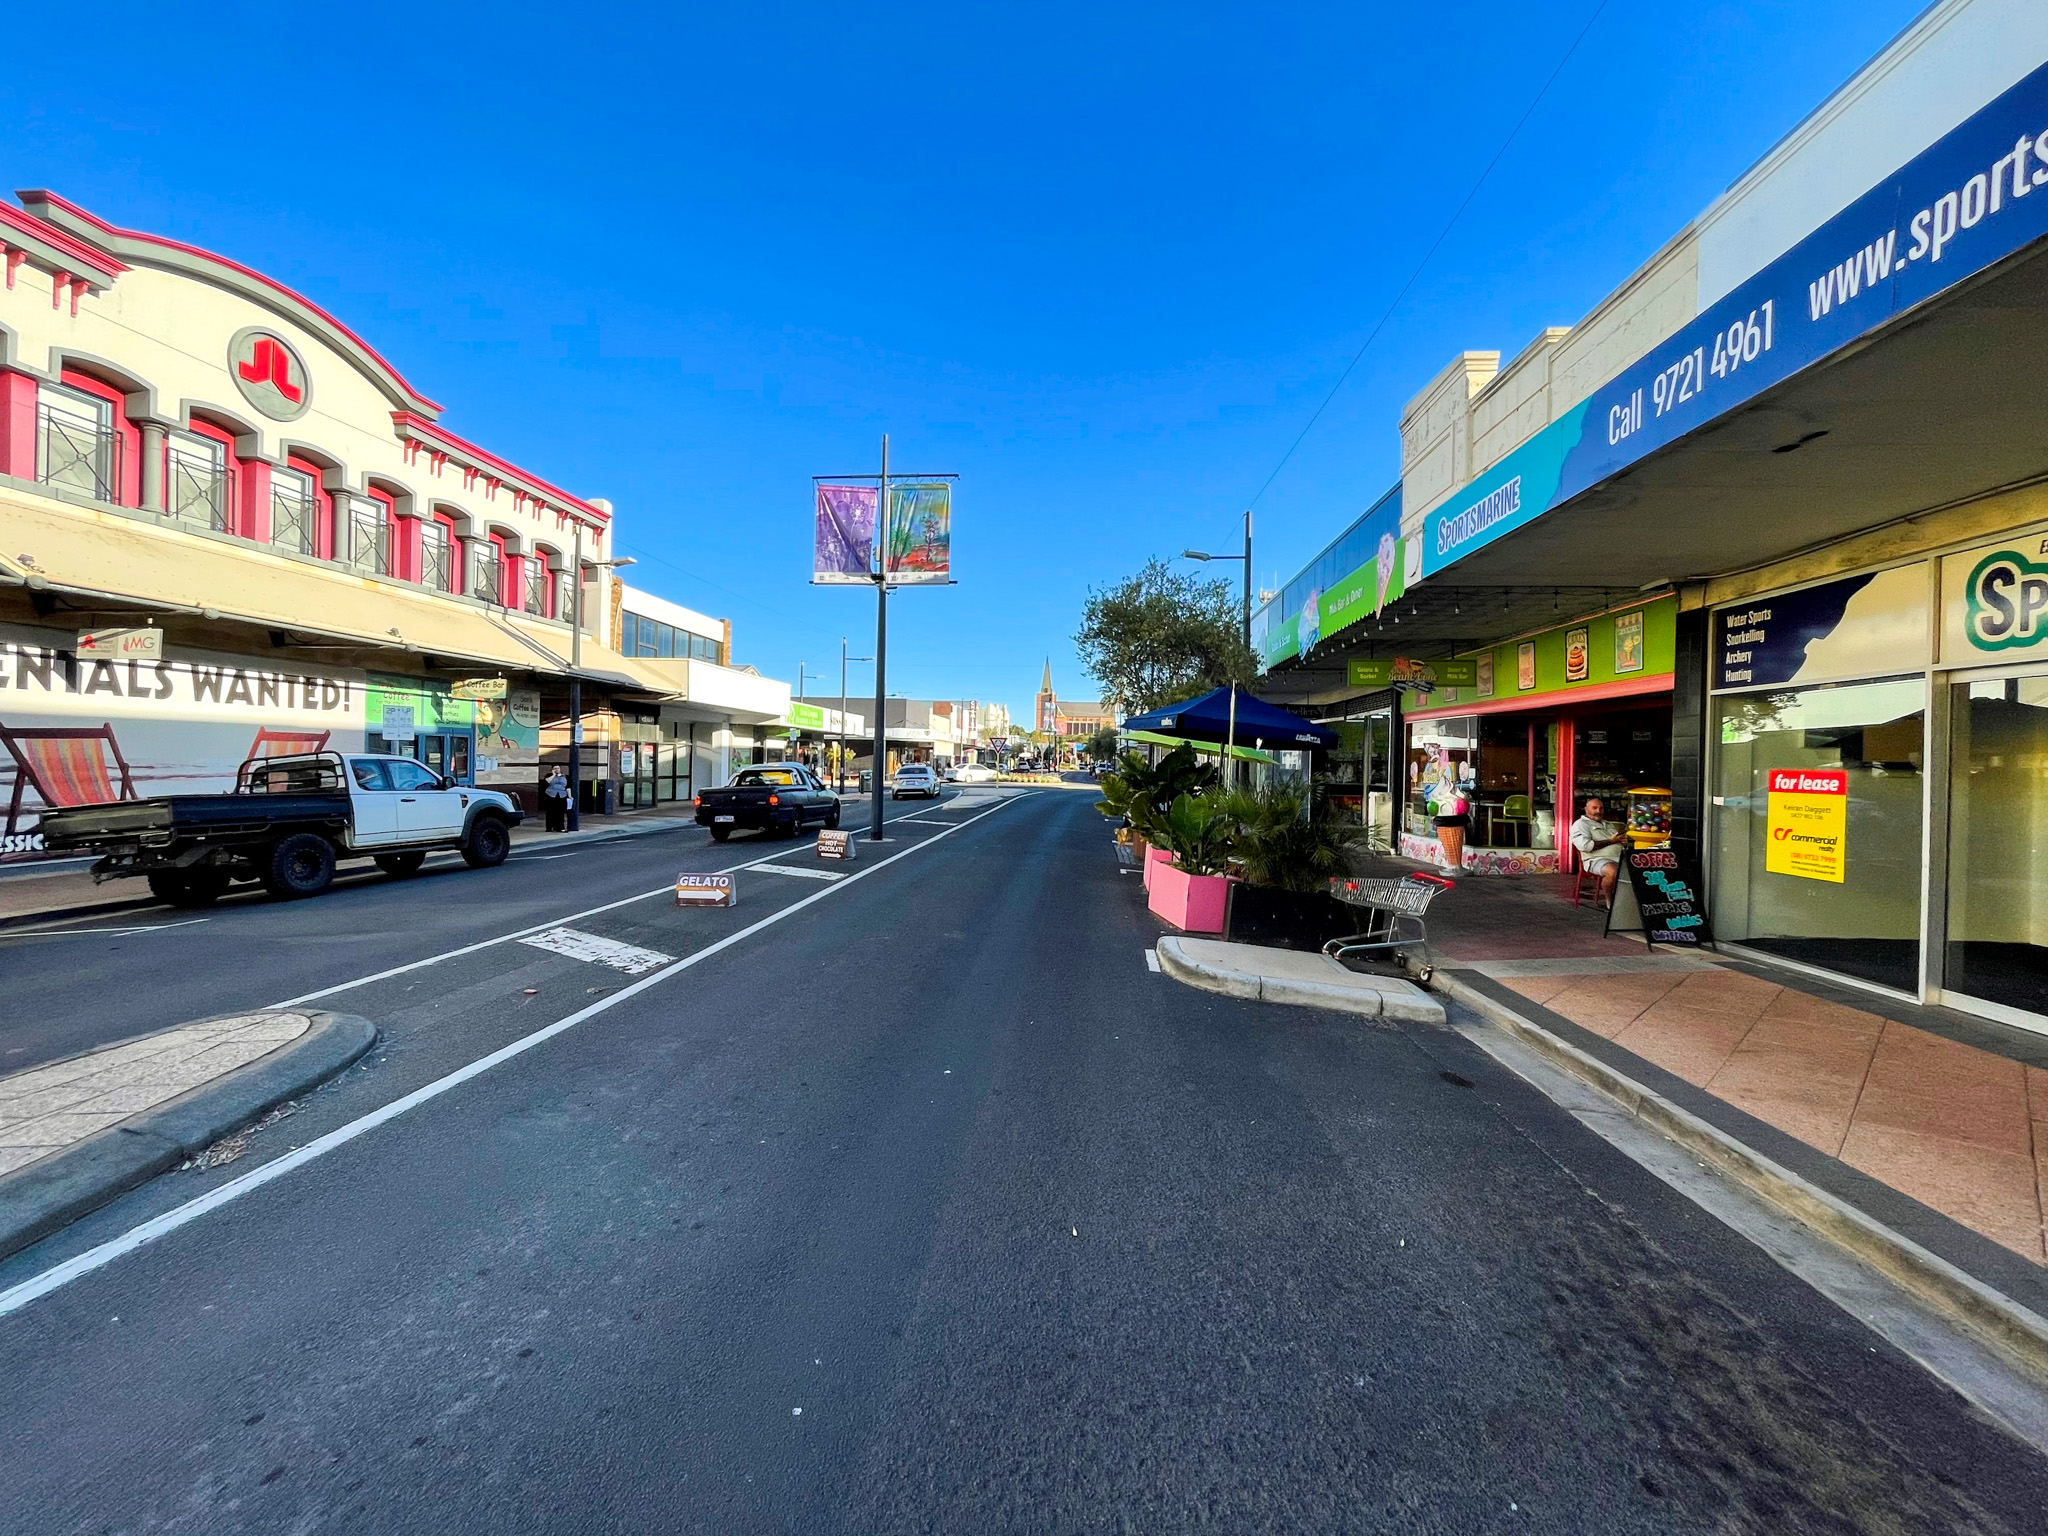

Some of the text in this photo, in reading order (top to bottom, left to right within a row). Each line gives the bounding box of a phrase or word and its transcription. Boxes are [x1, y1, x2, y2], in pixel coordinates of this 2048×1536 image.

[1608, 387, 1643, 446] Call
[1653, 346, 1703, 418] 9721
[1710, 299, 1773, 379] 4961
[1437, 475, 1520, 555] SPORTSMARINE
[1726, 609, 1772, 628] Water Sports
[1726, 629, 1765, 646] Snorkelling
[1725, 650, 1752, 664] Archery
[1725, 669, 1752, 682] Hunting
[190, 663, 350, 712] WANTED!
[467, 680, 490, 688] Coffee
[1775, 774, 1839, 791] for lease
[822, 831, 846, 839] COFFEE
[1791, 833, 1838, 845] commercial
[818, 845, 844, 853] CHOCOLATE
[1819, 845, 1836, 853] realty
[1630, 852, 1678, 868] COFFEE
[679, 876, 729, 887] GELATO
